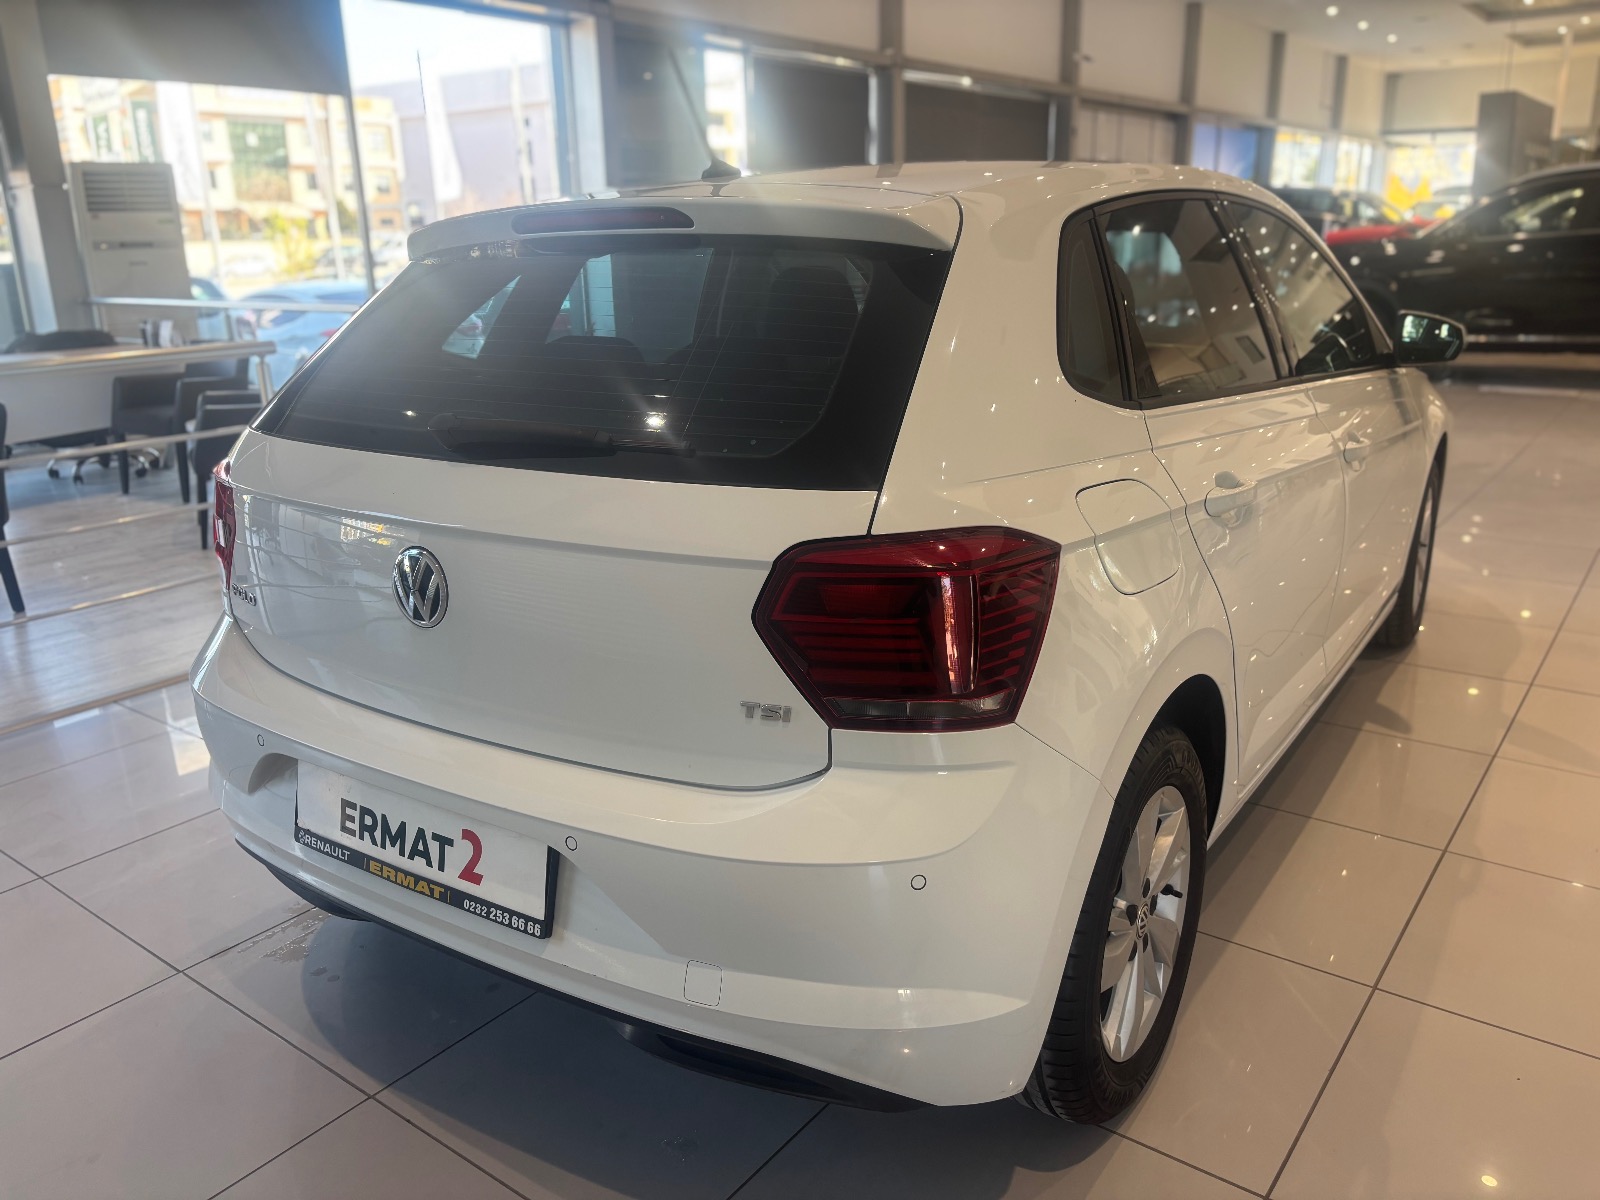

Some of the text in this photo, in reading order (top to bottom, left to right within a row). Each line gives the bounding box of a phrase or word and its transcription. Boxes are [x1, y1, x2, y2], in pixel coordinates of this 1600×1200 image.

[740, 701, 792, 723] TSI
[340, 798, 454, 873] ERMAT
[304, 835, 541, 937] RENAULT ERMAT 0232 253 66 66
